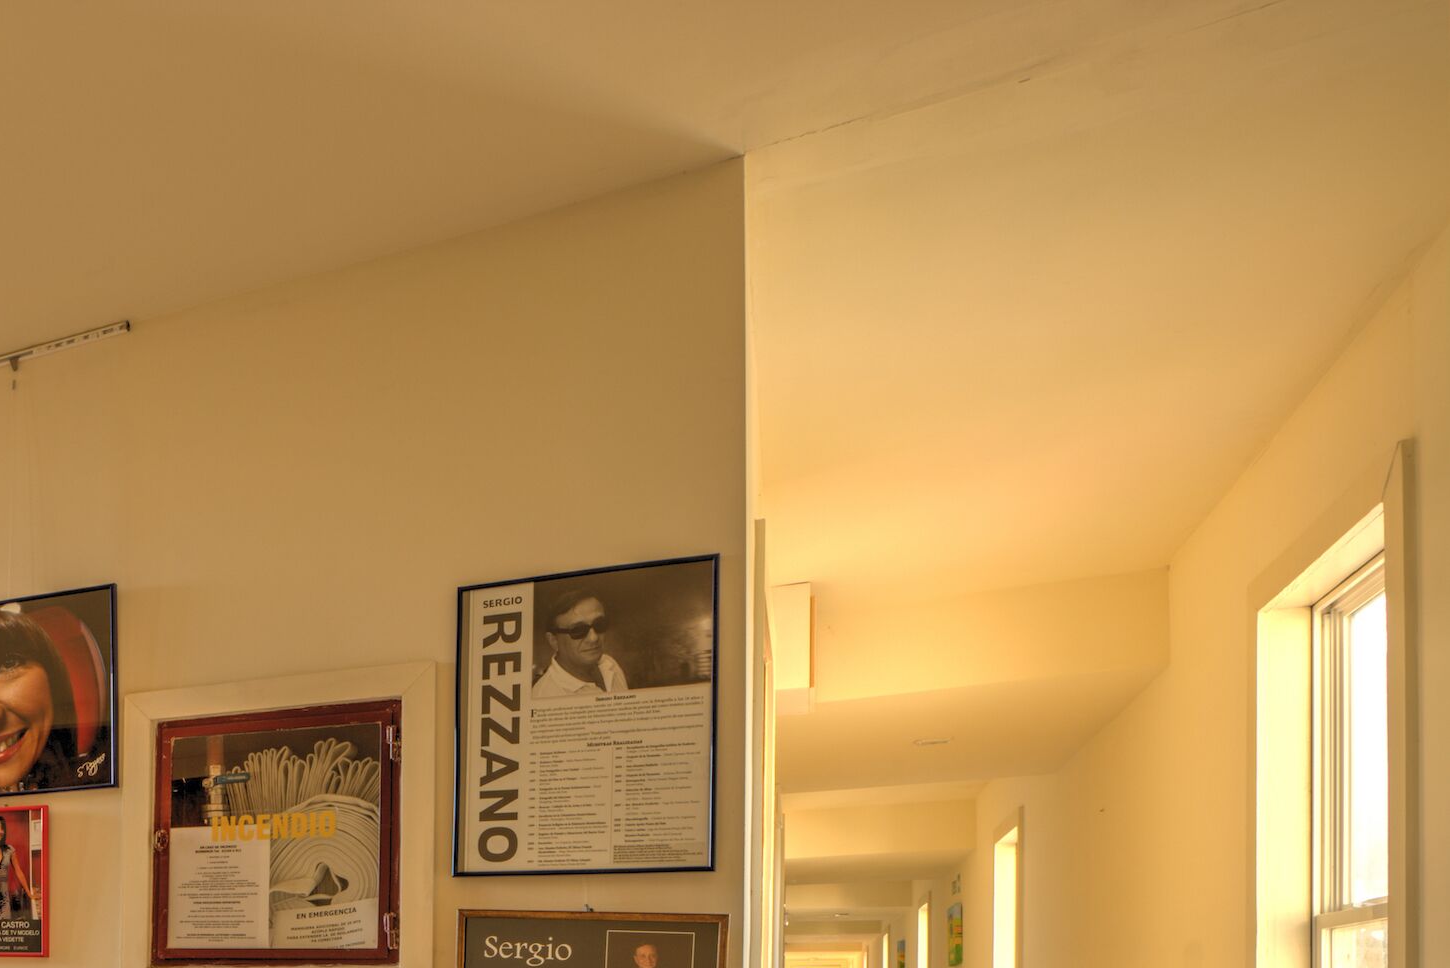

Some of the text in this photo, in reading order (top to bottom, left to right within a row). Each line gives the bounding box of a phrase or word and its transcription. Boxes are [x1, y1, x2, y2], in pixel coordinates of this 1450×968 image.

[482, 595, 524, 609] SERGIO
[477, 611, 523, 863] REZZANO
[211, 810, 337, 842] INCENDIO
[308, 907, 357, 919] EMERGENCIA
[1, 921, 30, 929] CASTRO
[483, 935, 572, 967] Sergio
